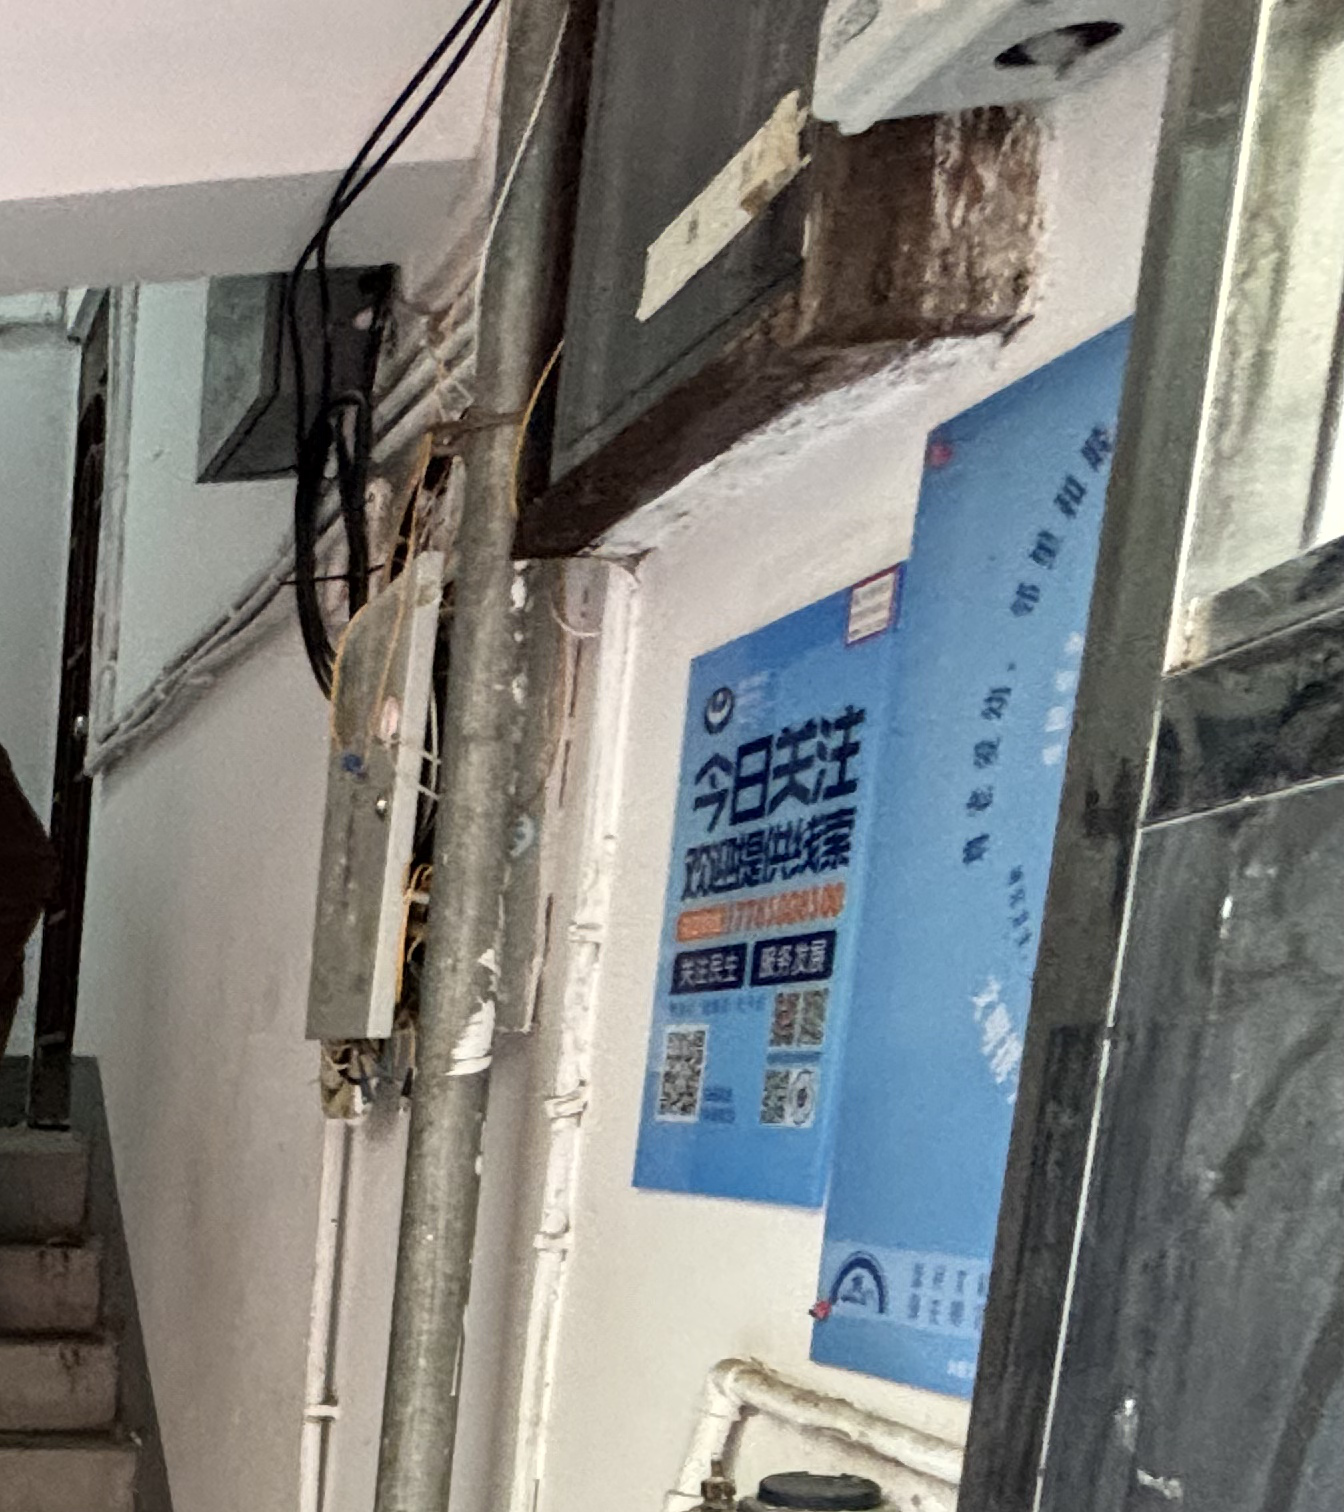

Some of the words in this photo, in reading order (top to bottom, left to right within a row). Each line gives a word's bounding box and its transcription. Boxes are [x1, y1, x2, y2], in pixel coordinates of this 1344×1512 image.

[693, 703, 867, 832] 今日关注
[681, 805, 858, 899] 欢迎提供线索
[678, 953, 741, 986] 关注民生
[758, 939, 829, 981] 服务发展
